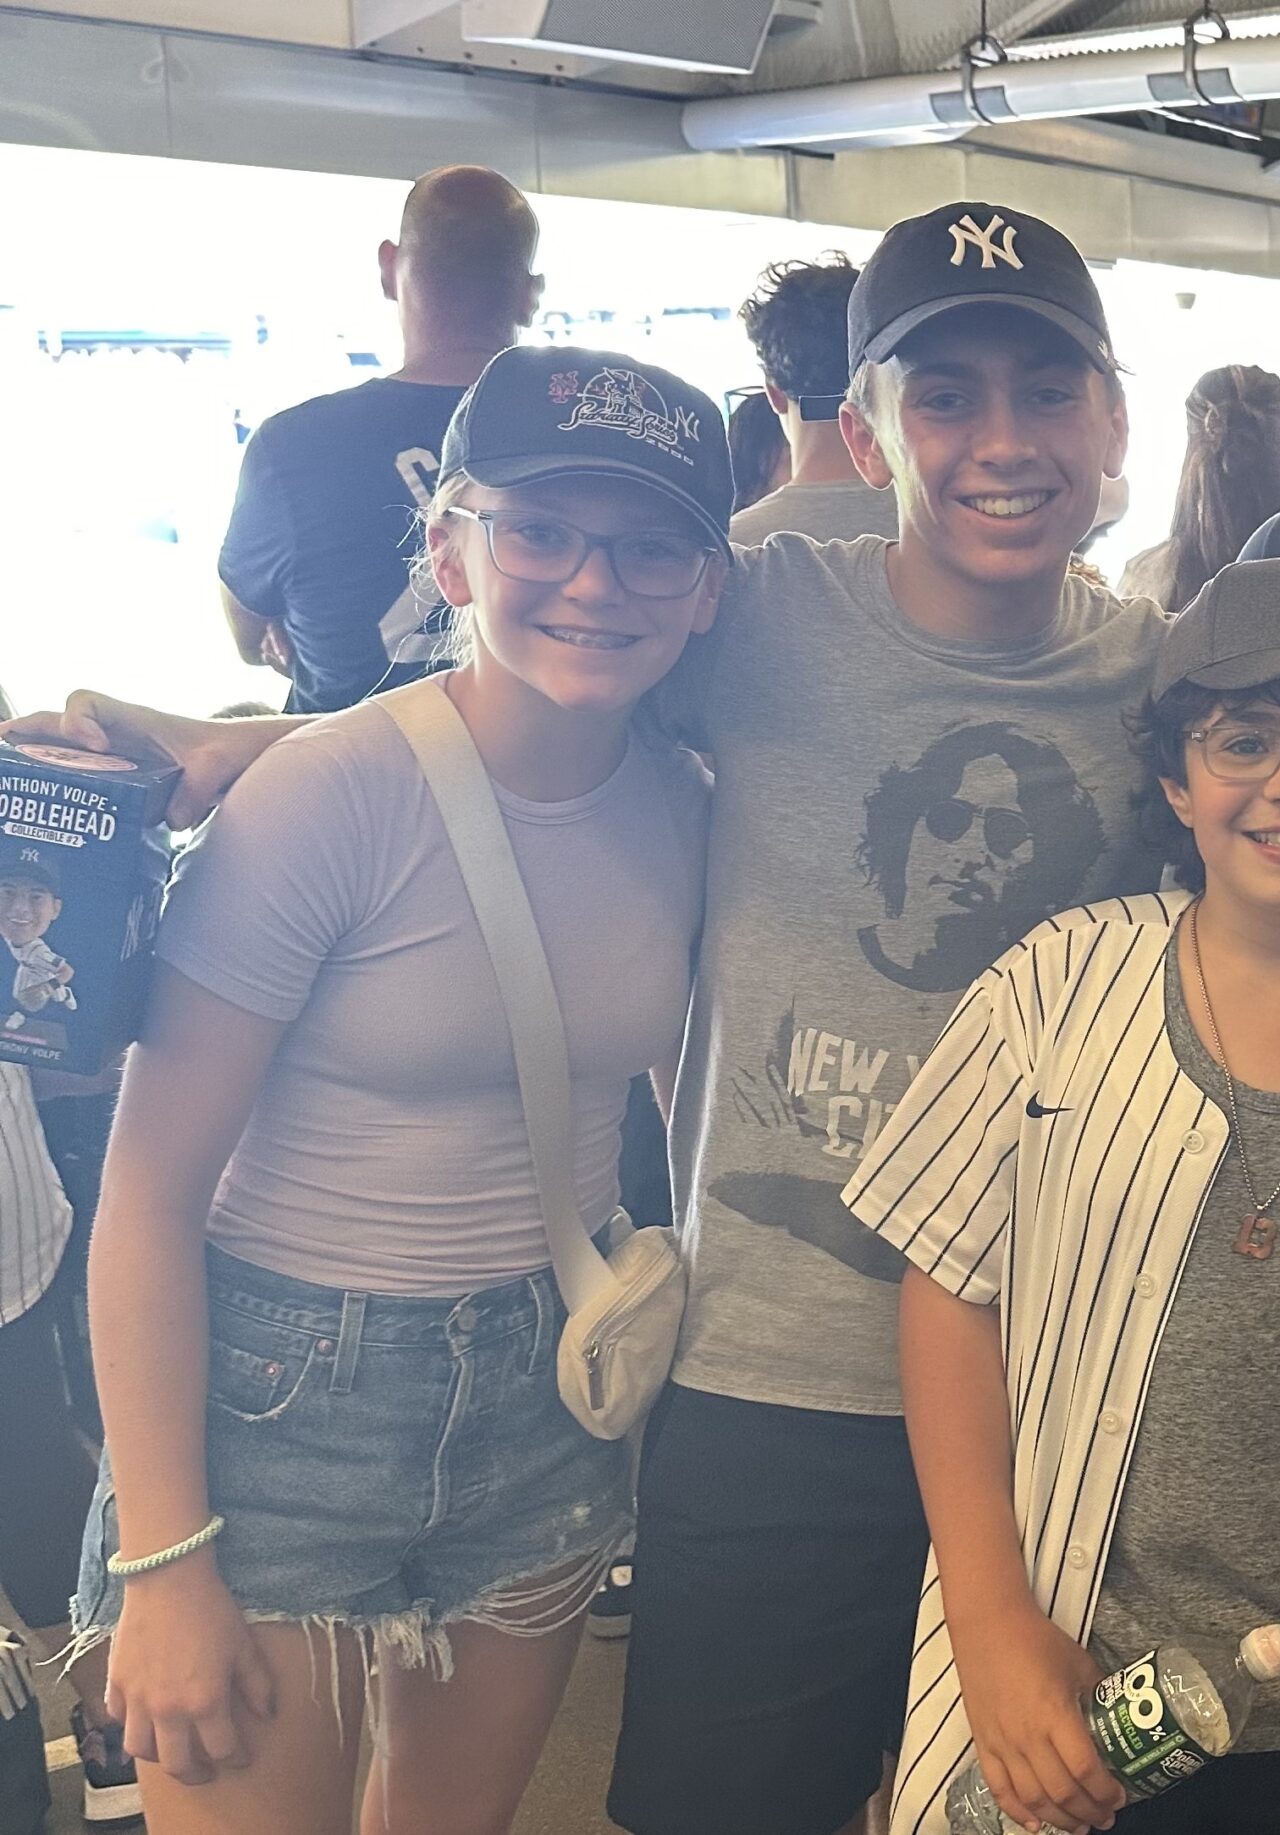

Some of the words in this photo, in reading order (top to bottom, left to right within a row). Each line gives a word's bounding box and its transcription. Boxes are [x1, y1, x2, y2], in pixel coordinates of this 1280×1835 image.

[948, 214, 1024, 271] NY
[0, 776, 60, 797] NTHONY
[63, 785, 108, 811] VOLPE
[0, 793, 116, 841] OBBLEHEAD
[787, 1028, 890, 1097] NEW
[821, 1095, 901, 1159] CI
[1117, 1703, 1143, 1750] RECYCLED
